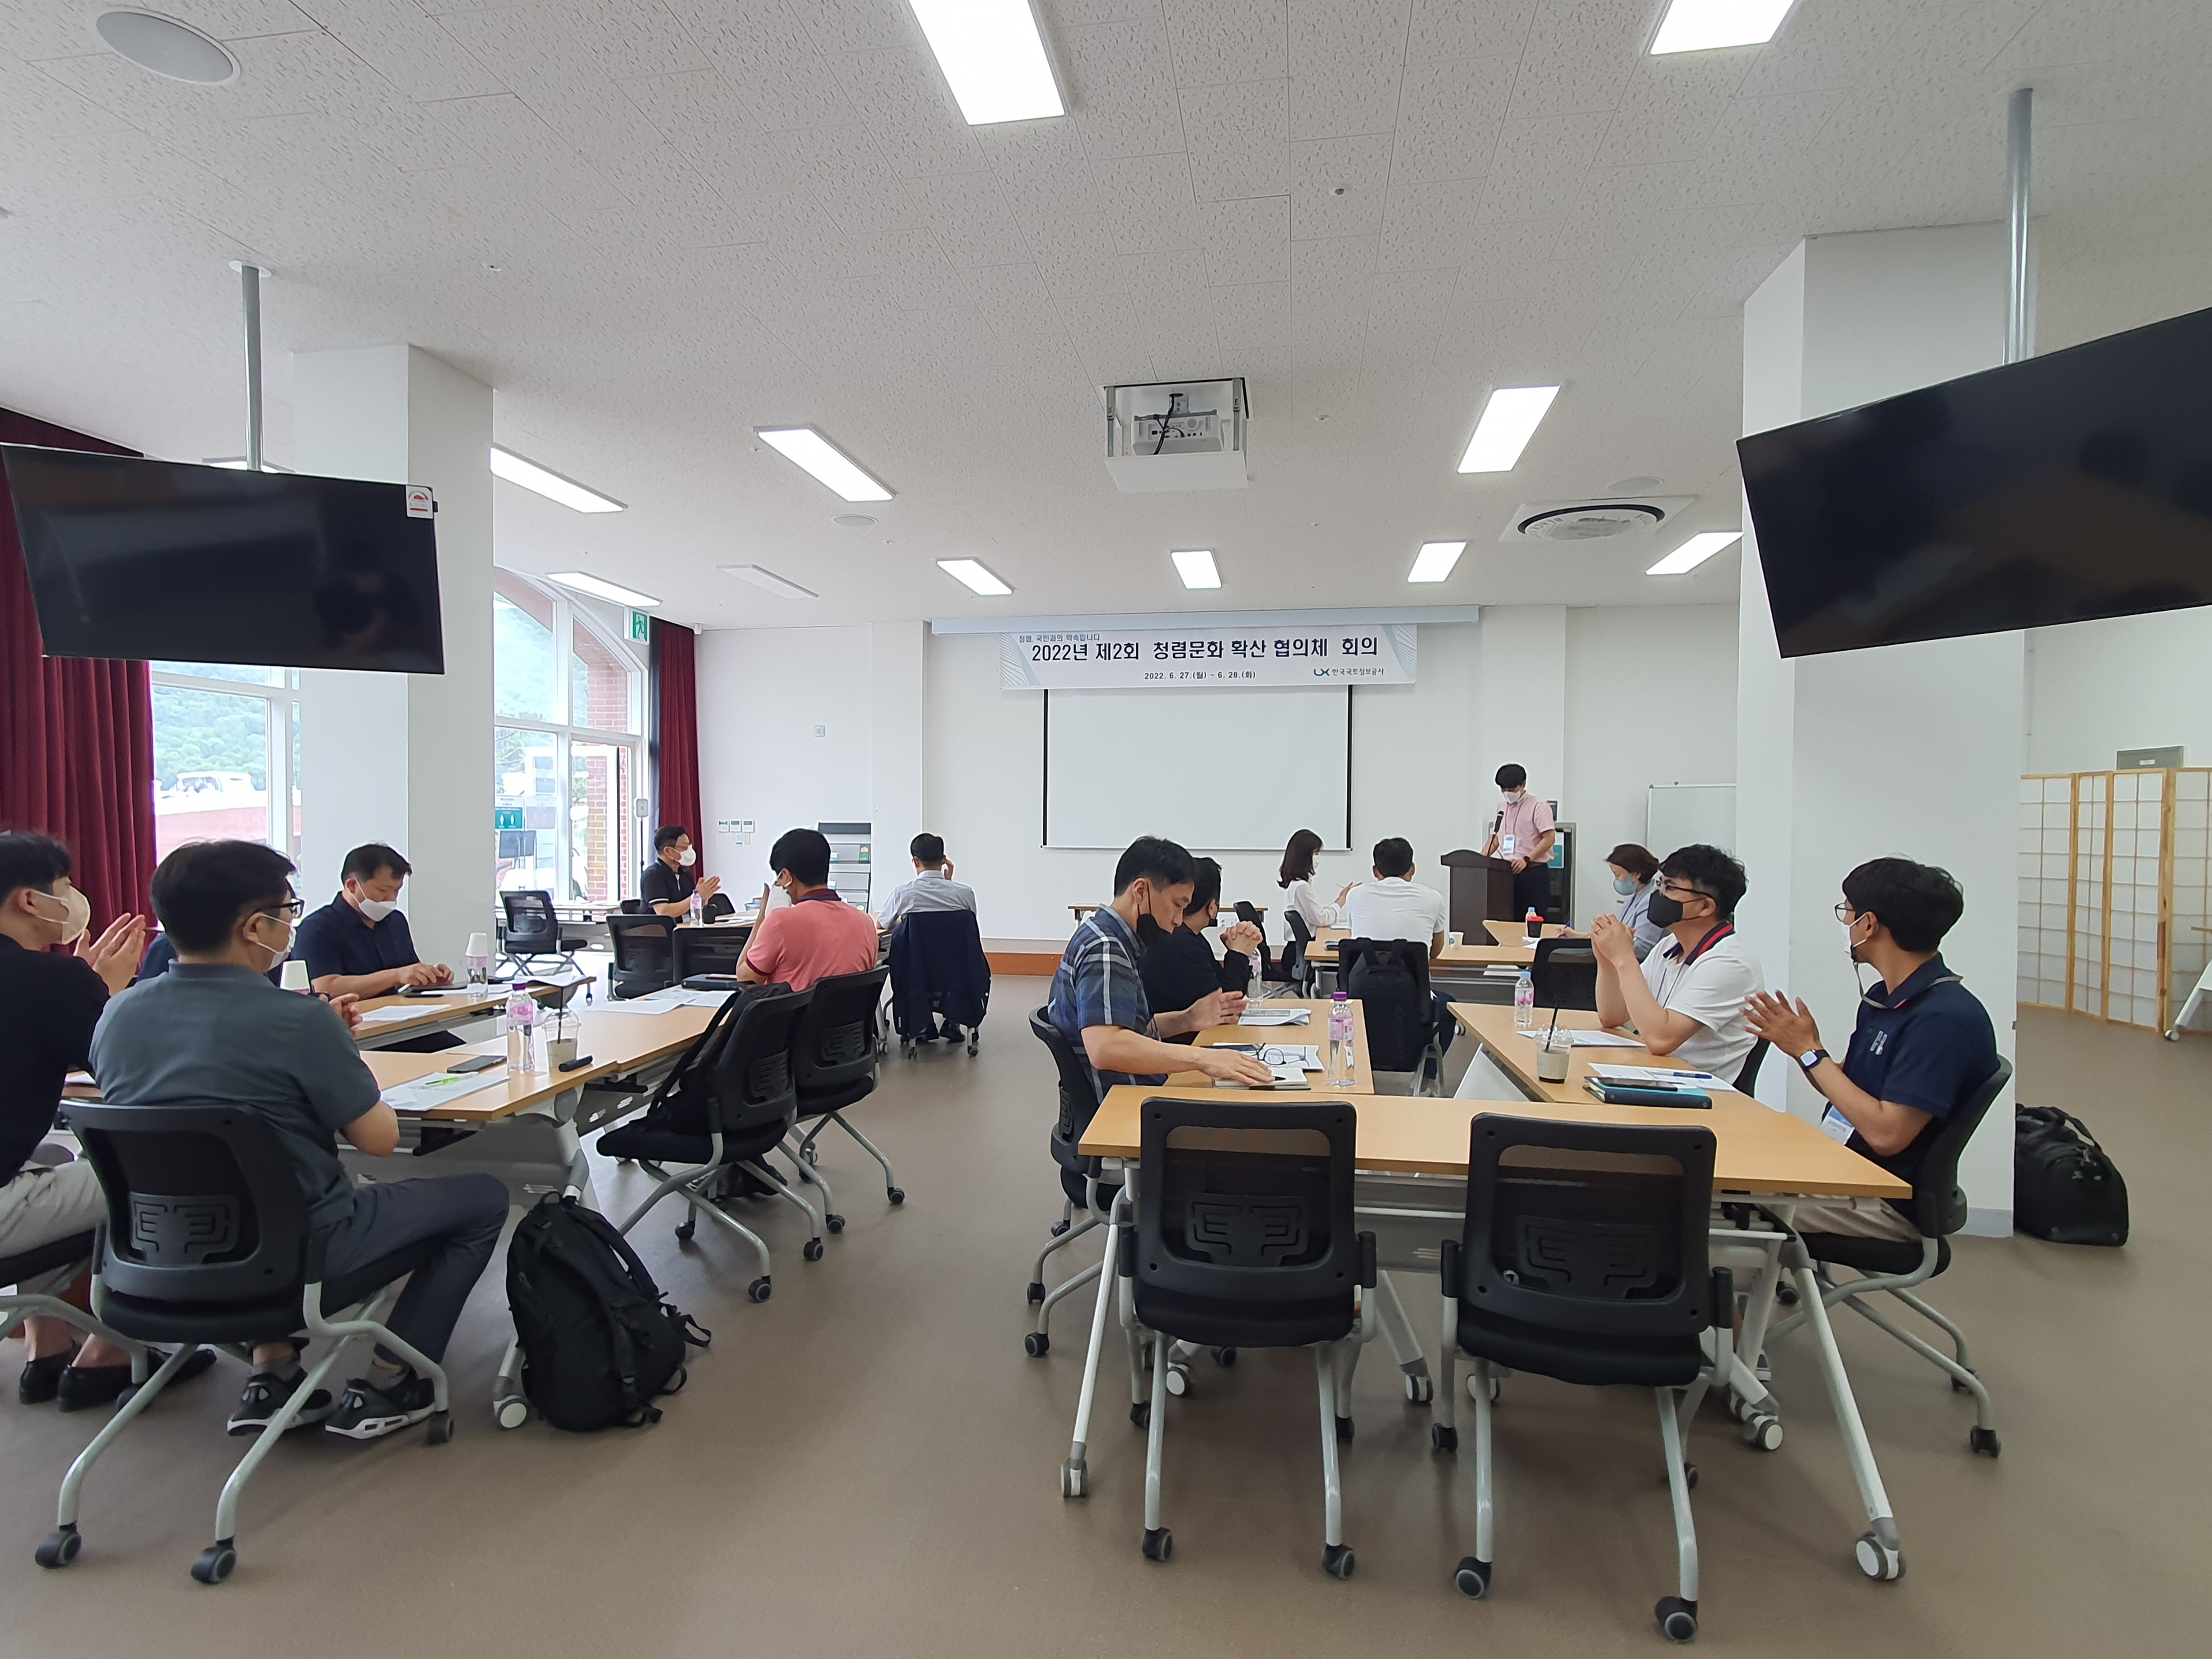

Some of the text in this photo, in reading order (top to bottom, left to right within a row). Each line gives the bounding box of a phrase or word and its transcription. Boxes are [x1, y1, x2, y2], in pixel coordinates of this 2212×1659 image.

[1036, 634, 1063, 642] 국민과의
[1066, 633, 1100, 641] 약속입니다
[1032, 637, 1377, 661] 2022년 제2회 청렴문화 확산 협의체 회의
